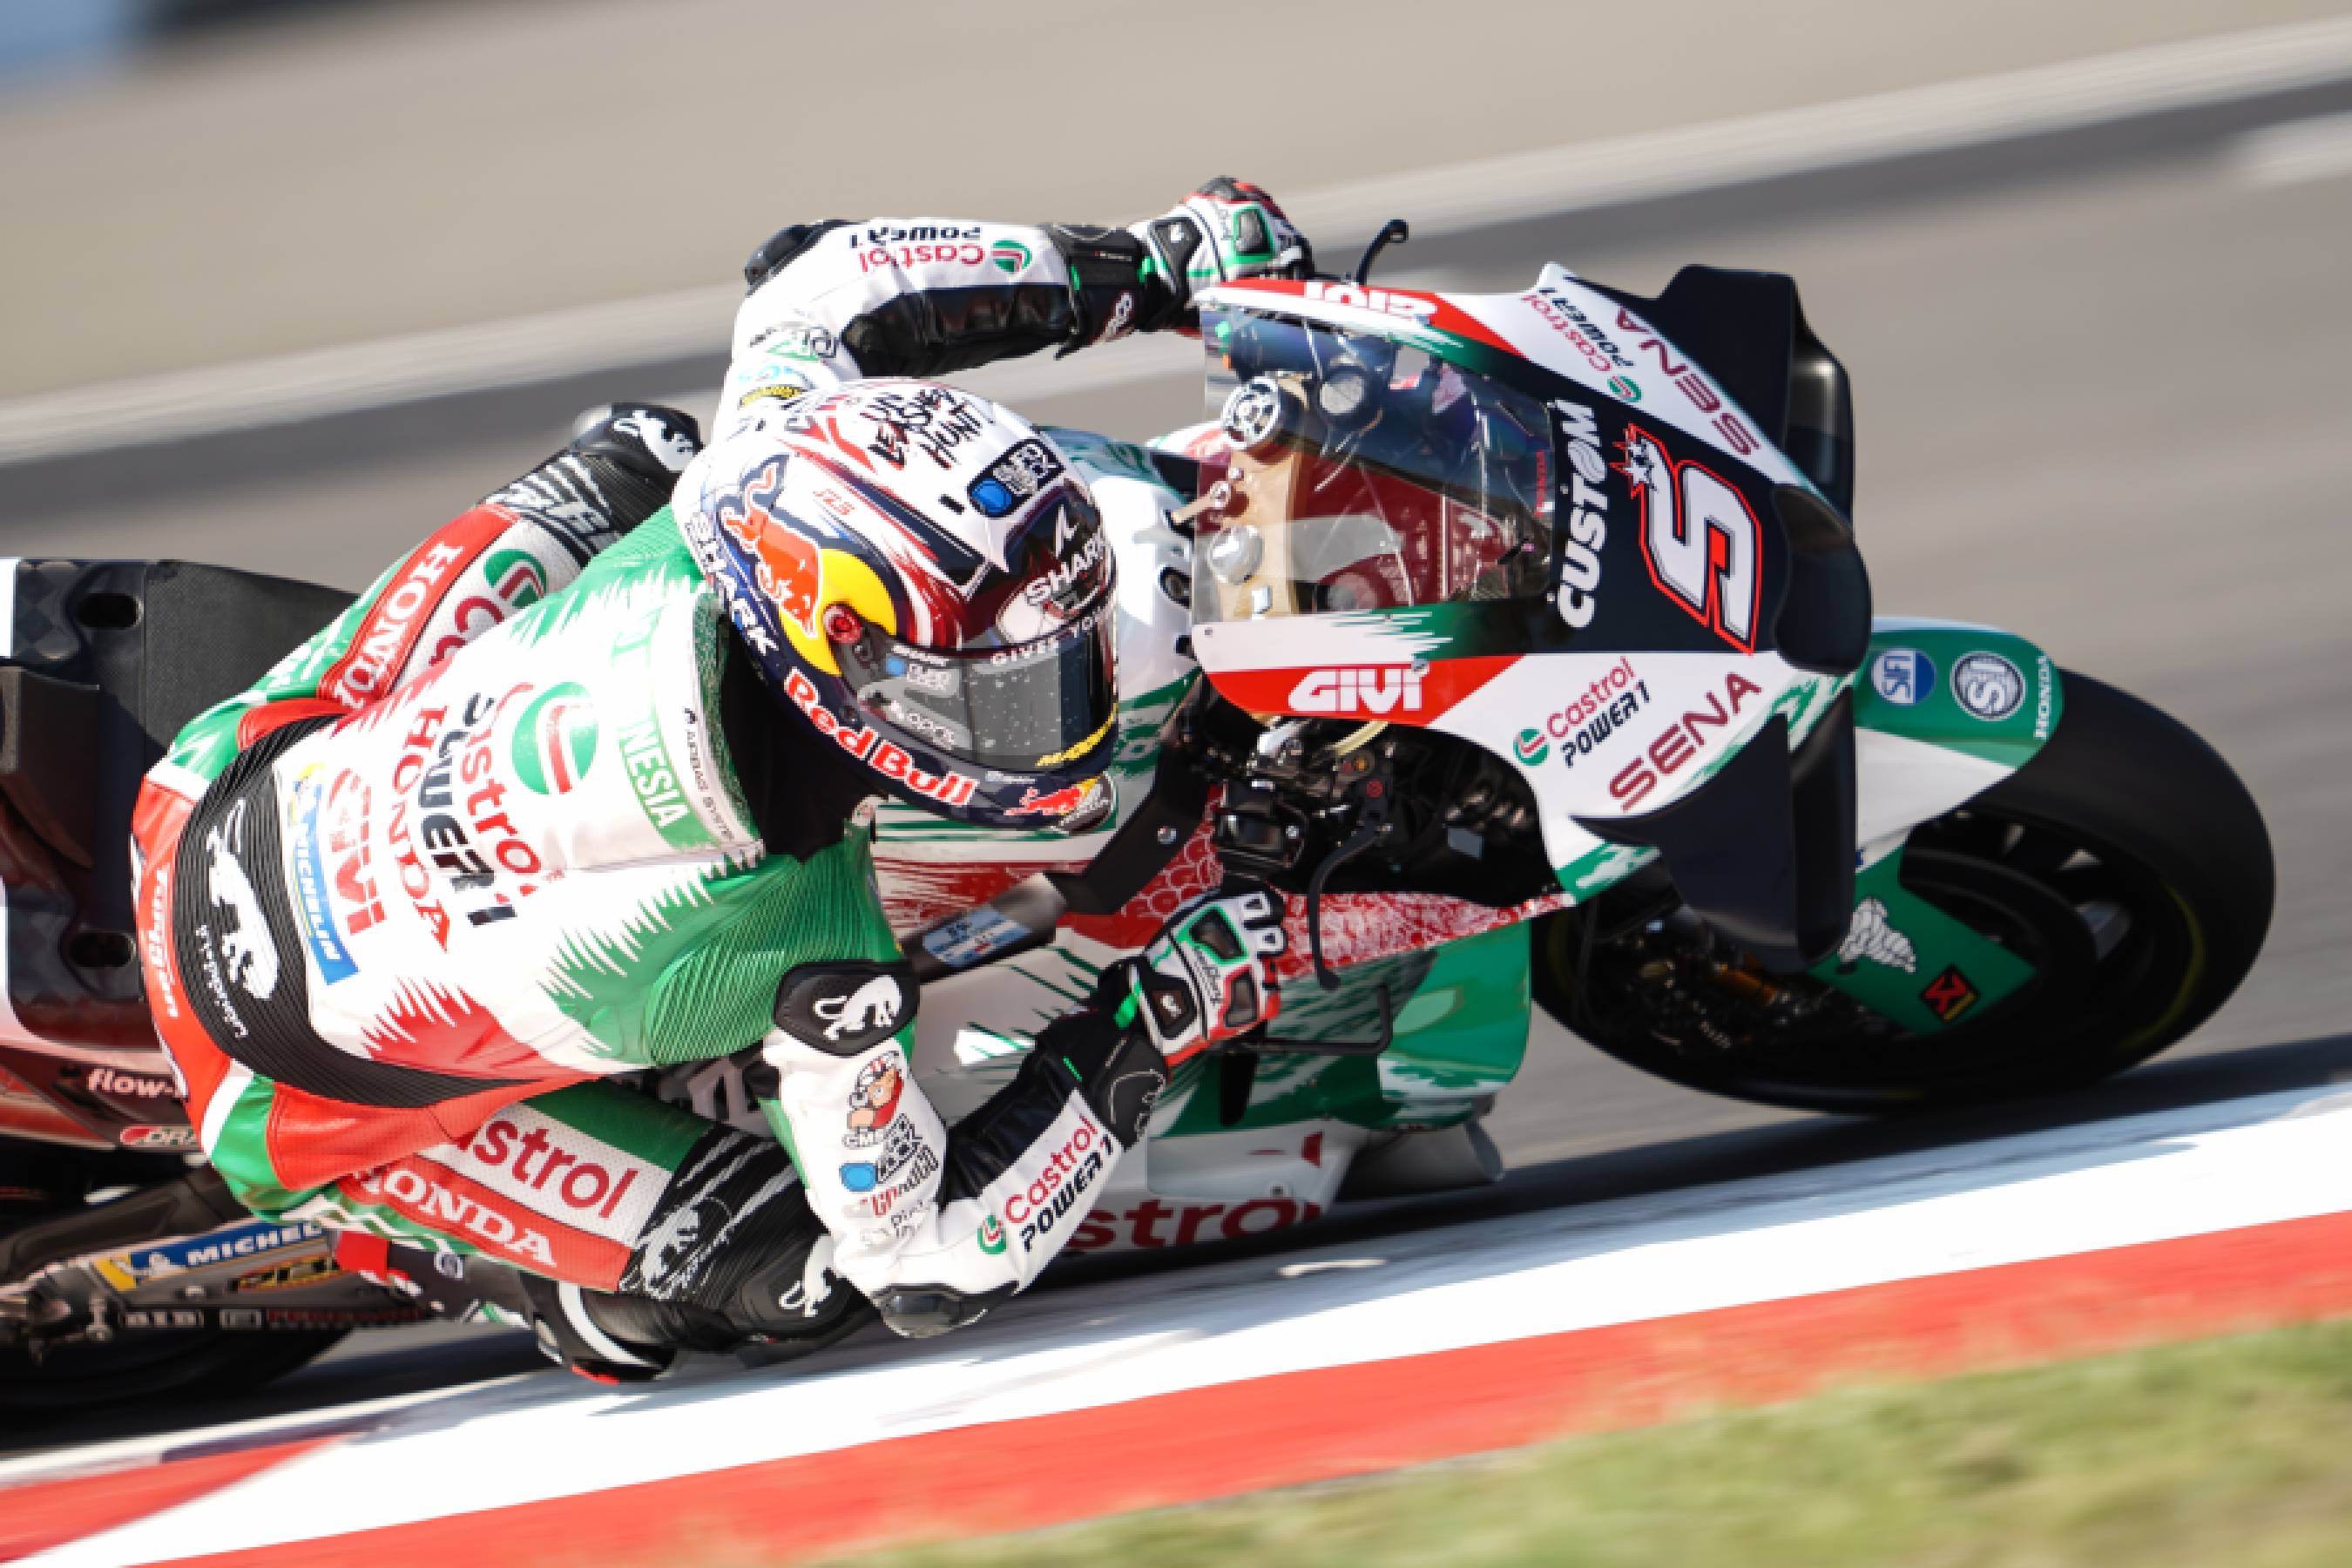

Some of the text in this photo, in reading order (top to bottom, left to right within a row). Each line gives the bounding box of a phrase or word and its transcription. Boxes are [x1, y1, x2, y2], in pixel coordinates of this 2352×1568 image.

[1521, 294, 1611, 372] Castrol
[1615, 305, 1761, 455] SENA
[685, 510, 779, 656] SHARK
[1554, 399, 1609, 628] CUSTOM
[1629, 425, 1761, 655] 5
[333, 542, 465, 710] HONDA
[1289, 667, 1429, 713] GIVI
[1547, 656, 1635, 738] Castrol
[784, 666, 878, 761] Red
[868, 740, 981, 807] Bull
[1608, 671, 1762, 813] SENA
[389, 706, 451, 956] HONDA
[463, 1120, 639, 1220] strol
[1004, 1114, 1098, 1225] Castrol
